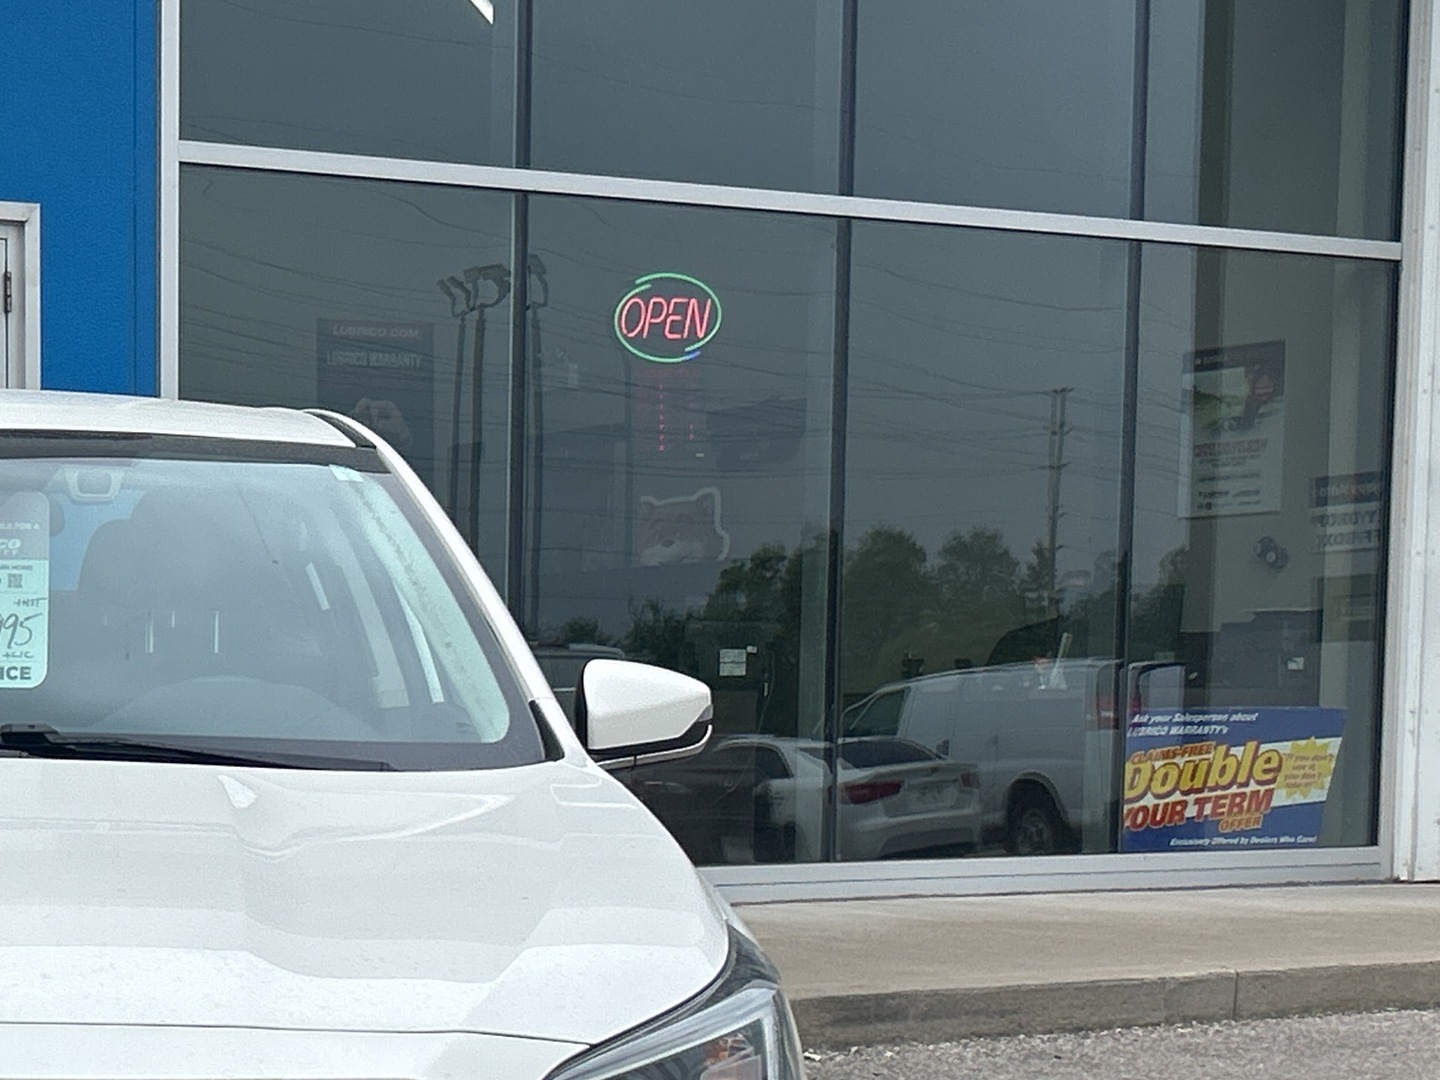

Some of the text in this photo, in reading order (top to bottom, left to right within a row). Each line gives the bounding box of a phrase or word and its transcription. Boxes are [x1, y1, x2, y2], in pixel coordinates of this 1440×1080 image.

[621, 297, 712, 339] OPEN
[33, 522, 41, 530] A
[1132, 714, 1149, 723] Ask
[1149, 715, 1172, 724] your
[1229, 712, 1259, 722] about
[1124, 741, 1282, 804] Double
[1194, 788, 1275, 821] TERM
[1219, 815, 1262, 831] OFFER
